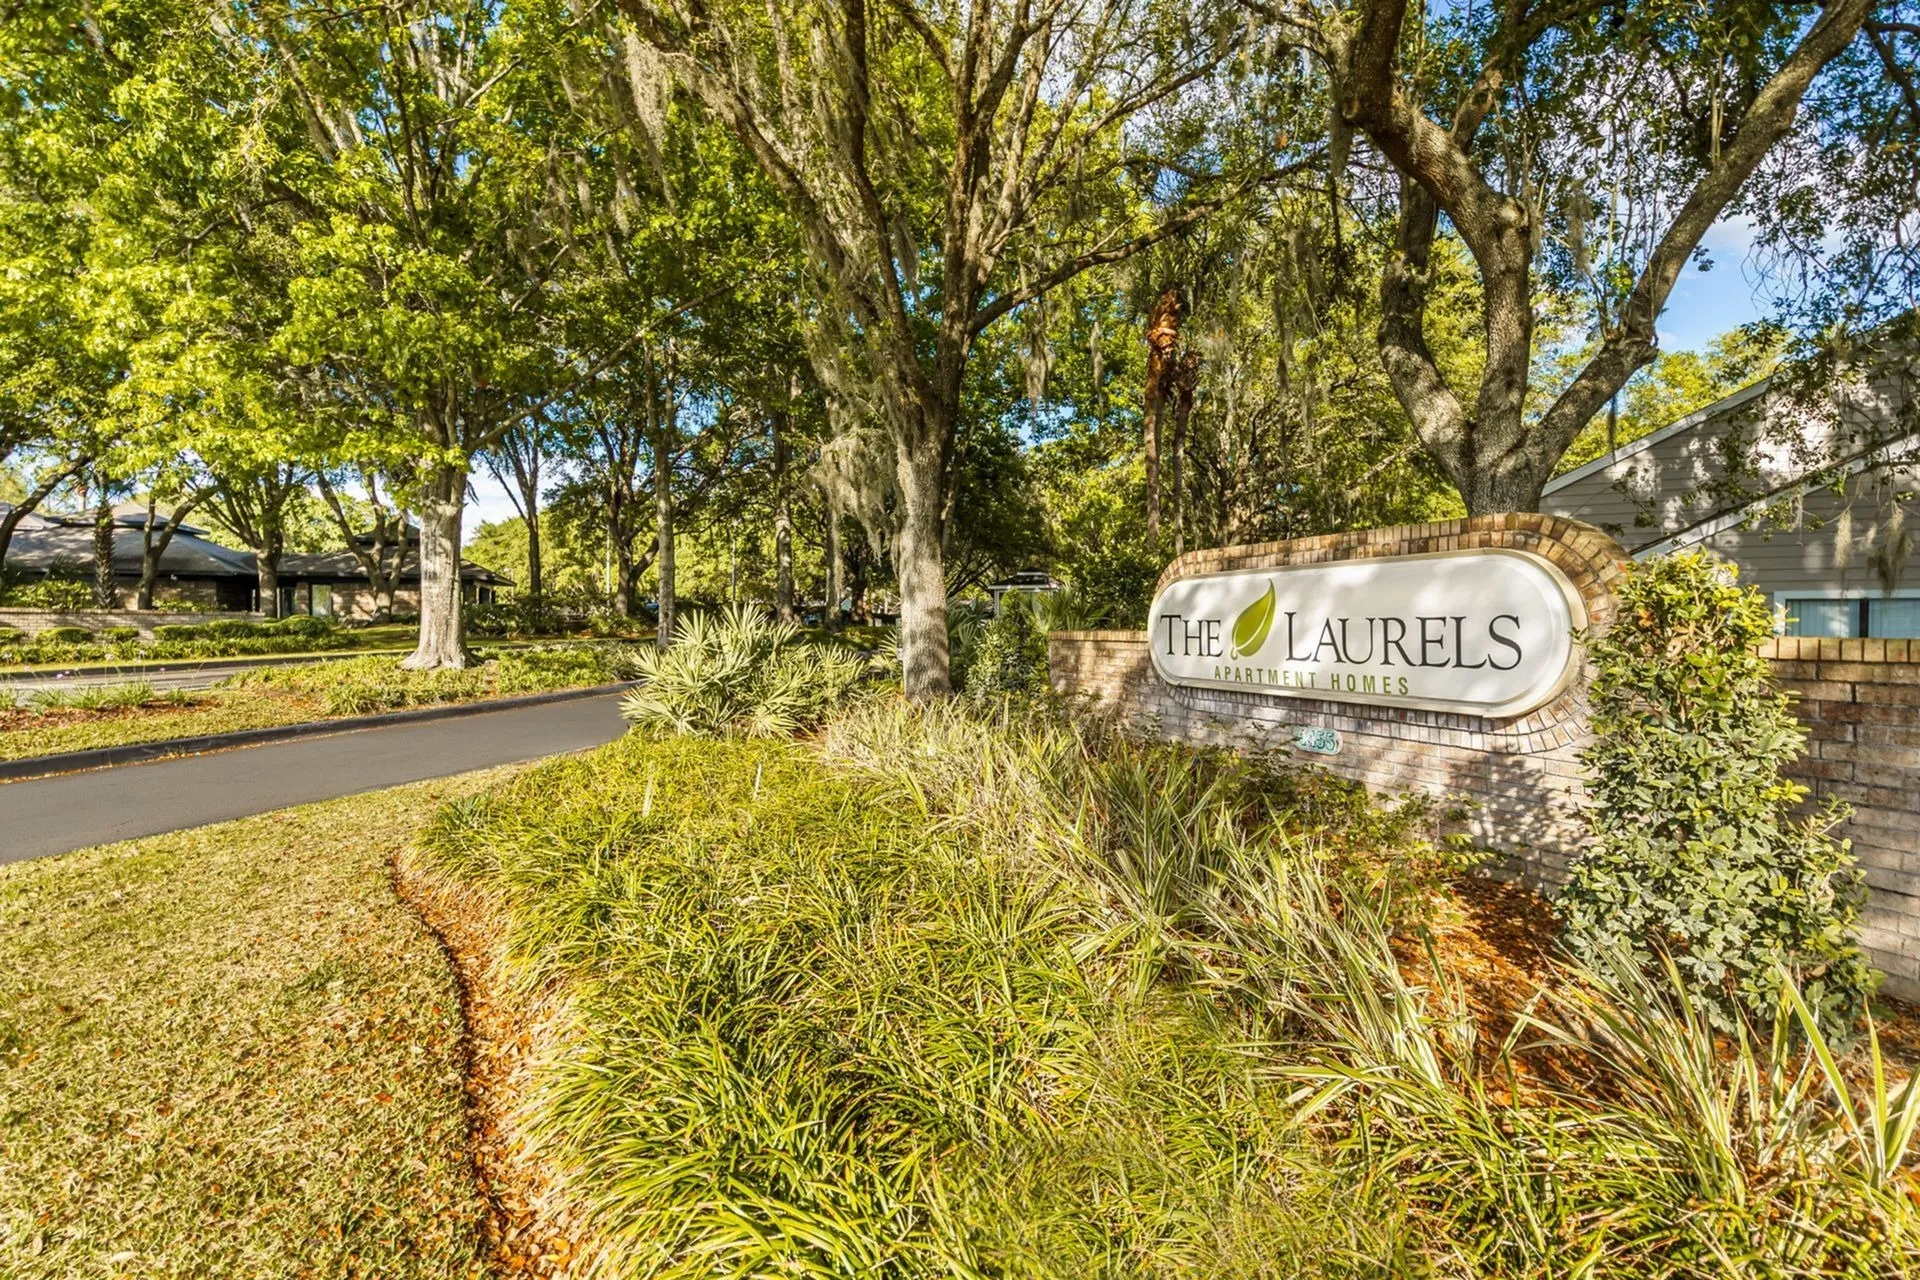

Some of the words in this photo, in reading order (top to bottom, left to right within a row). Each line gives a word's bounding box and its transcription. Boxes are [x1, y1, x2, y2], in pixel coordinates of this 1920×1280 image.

[1160, 614, 1222, 657] THE
[1285, 611, 1522, 671] LAURELS
[1214, 665, 1317, 689] APARTMENT
[1331, 673, 1409, 696] HOMES
